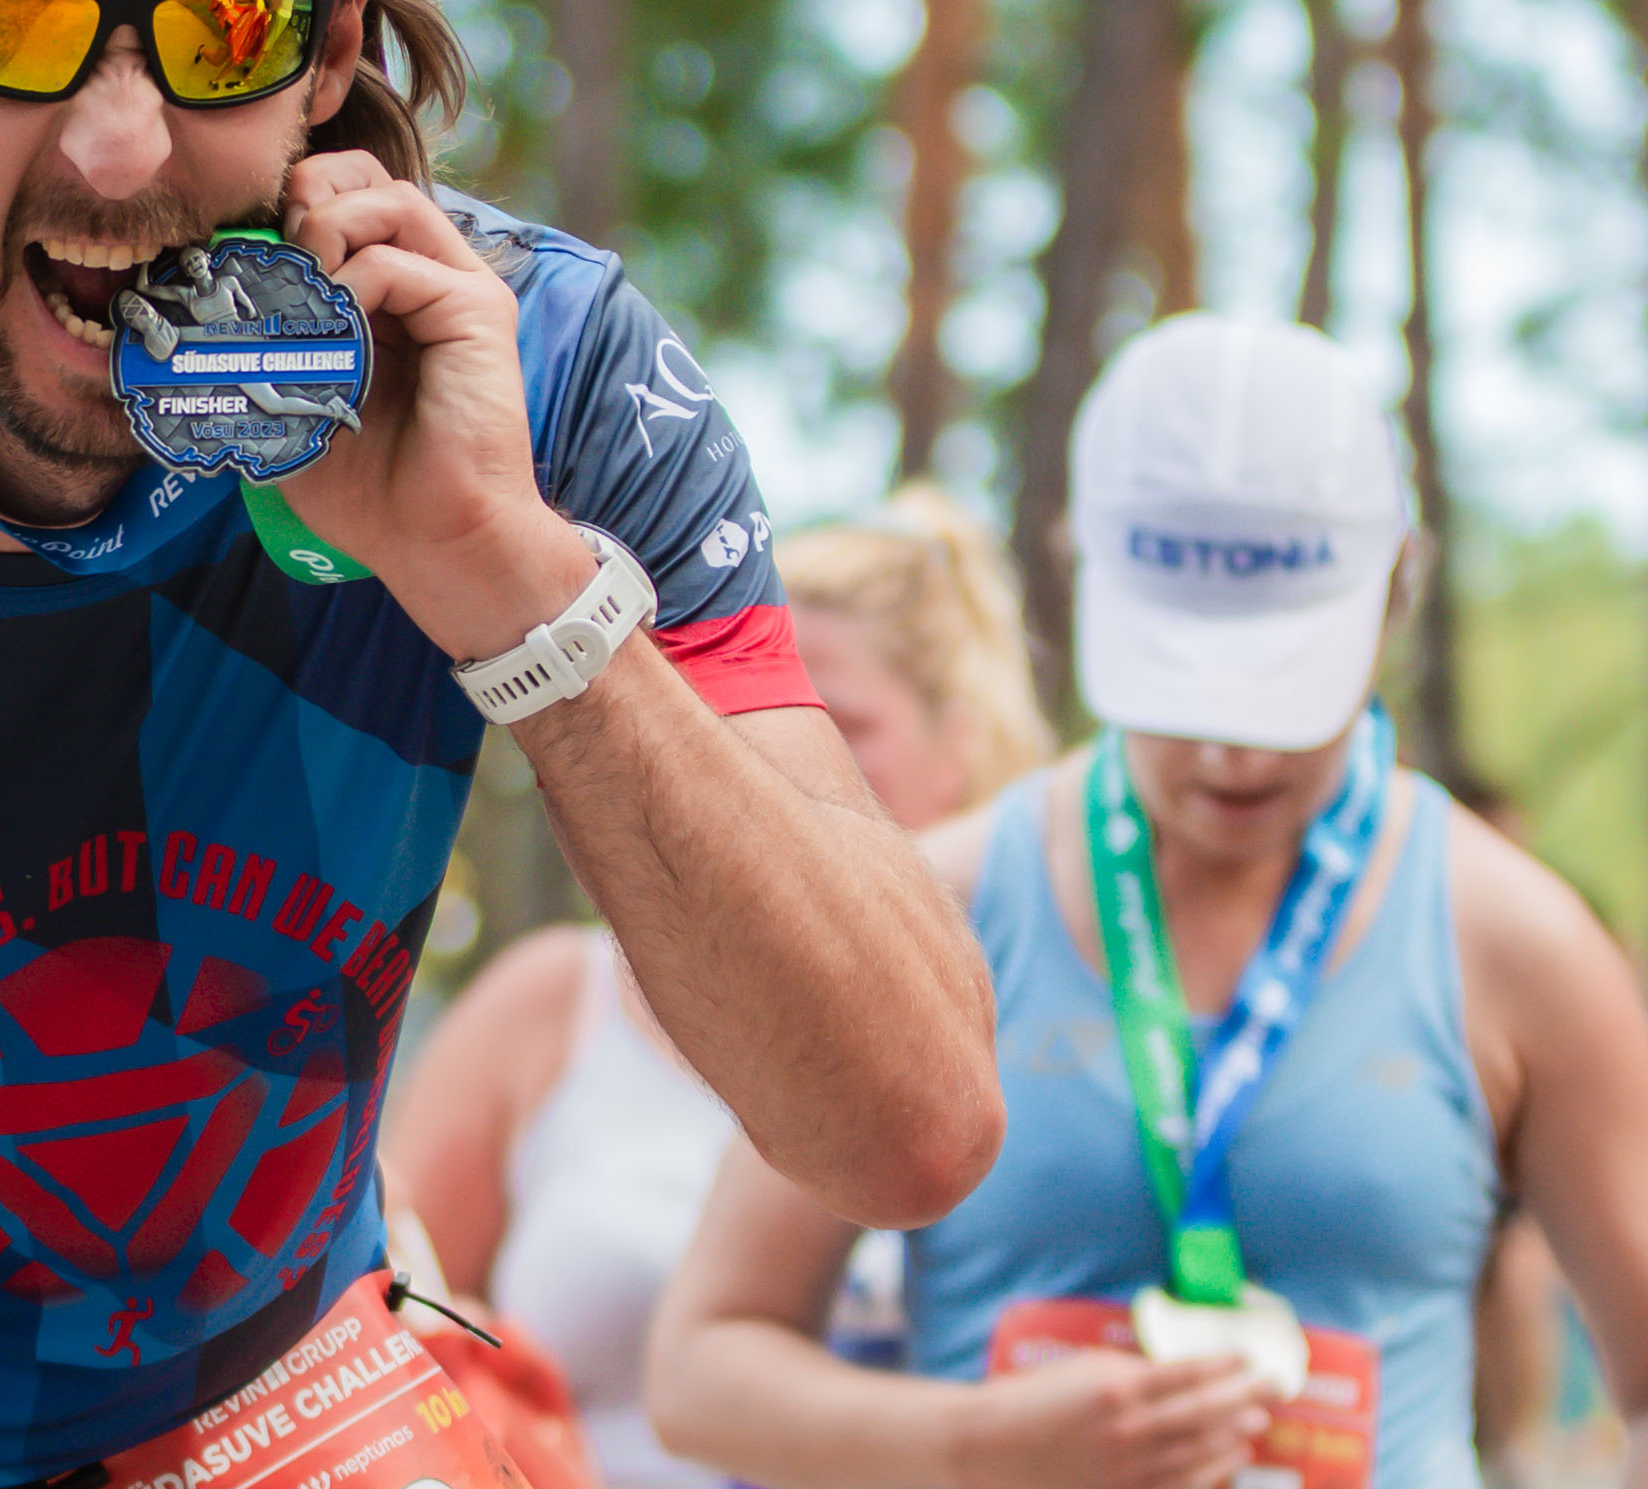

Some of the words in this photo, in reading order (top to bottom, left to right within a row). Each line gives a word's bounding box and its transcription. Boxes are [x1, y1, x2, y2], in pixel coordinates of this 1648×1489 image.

[205, 319, 262, 336] REVIN
[282, 318, 349, 336] GRUPP
[171, 349, 262, 374] SÜDASUVE
[262, 349, 356, 373] CHALLENGE
[158, 395, 248, 415] FINISHER
[236, 421, 286, 439] 2023
[1126, 522, 1335, 577] ESTONIA
[47, 830, 148, 913] BUT
[159, 828, 278, 921] CAN
[272, 873, 365, 964] WE
[340, 917, 415, 1020] BEAT
[286, 1317, 363, 1375] GRUPP
